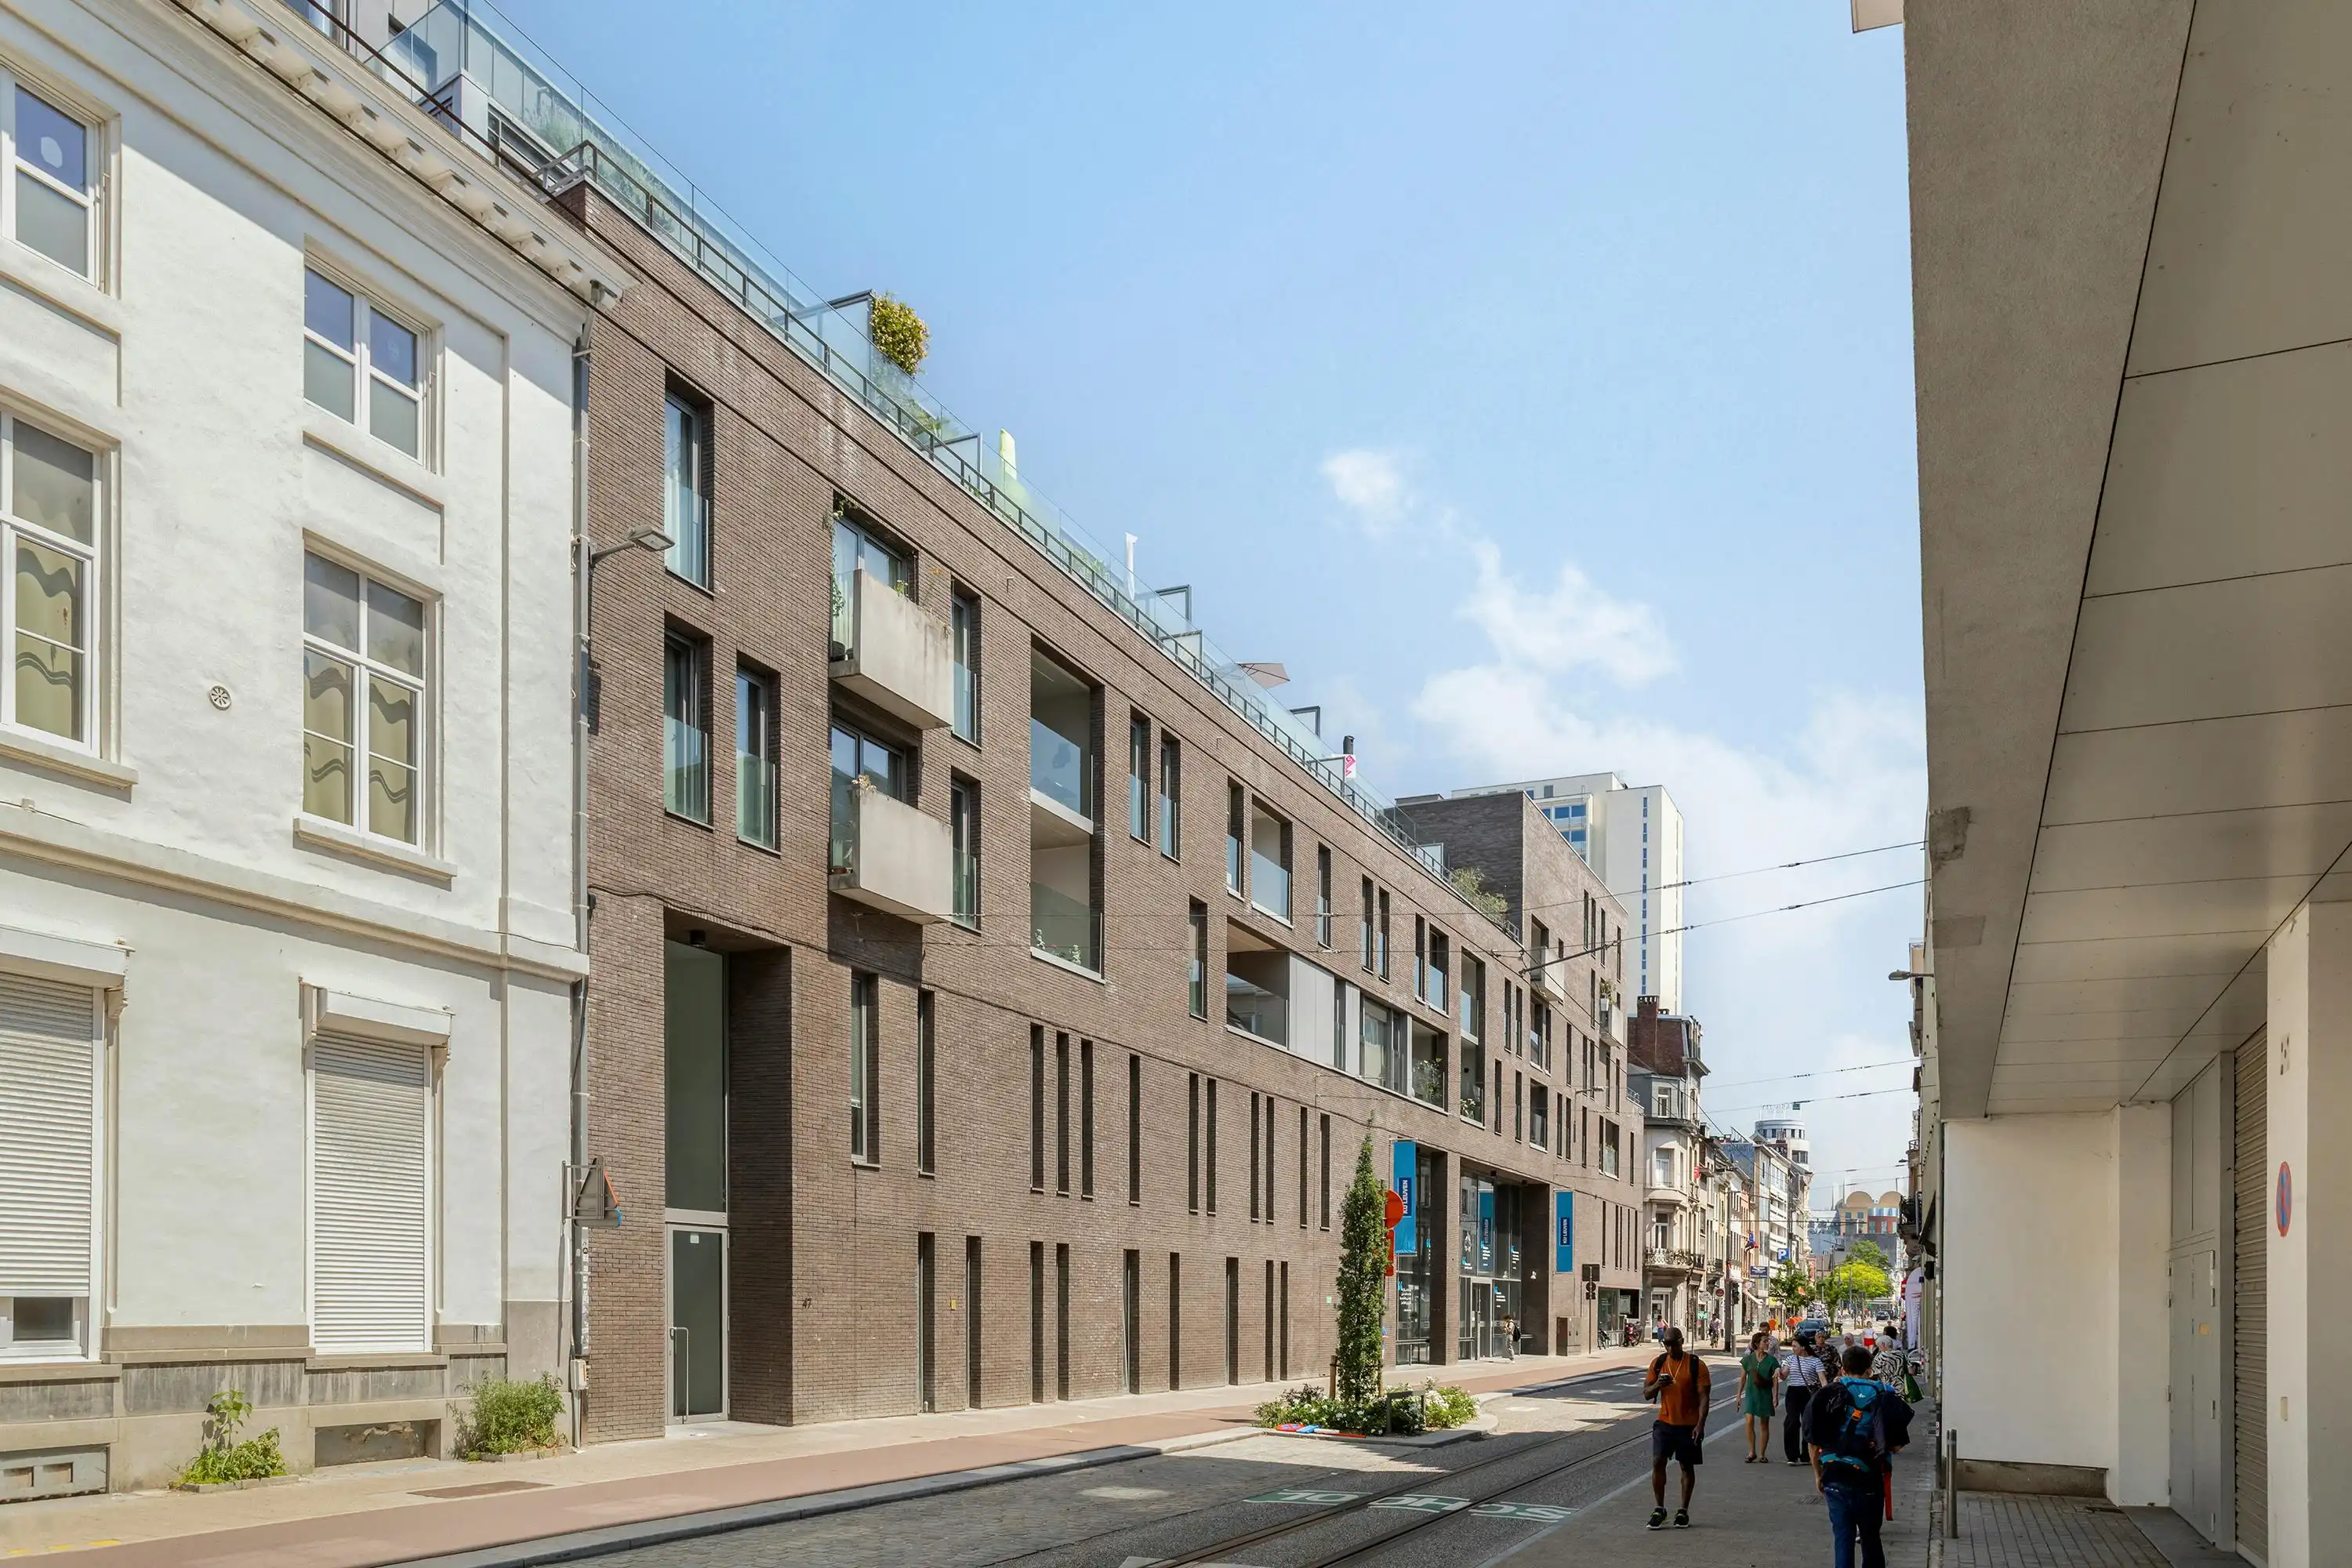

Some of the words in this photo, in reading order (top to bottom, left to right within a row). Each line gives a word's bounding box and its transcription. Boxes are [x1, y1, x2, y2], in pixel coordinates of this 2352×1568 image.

[1403, 1205, 1408, 1214] KU
[1778, 1249, 1787, 1260] P
[802, 1298, 811, 1308] 47
